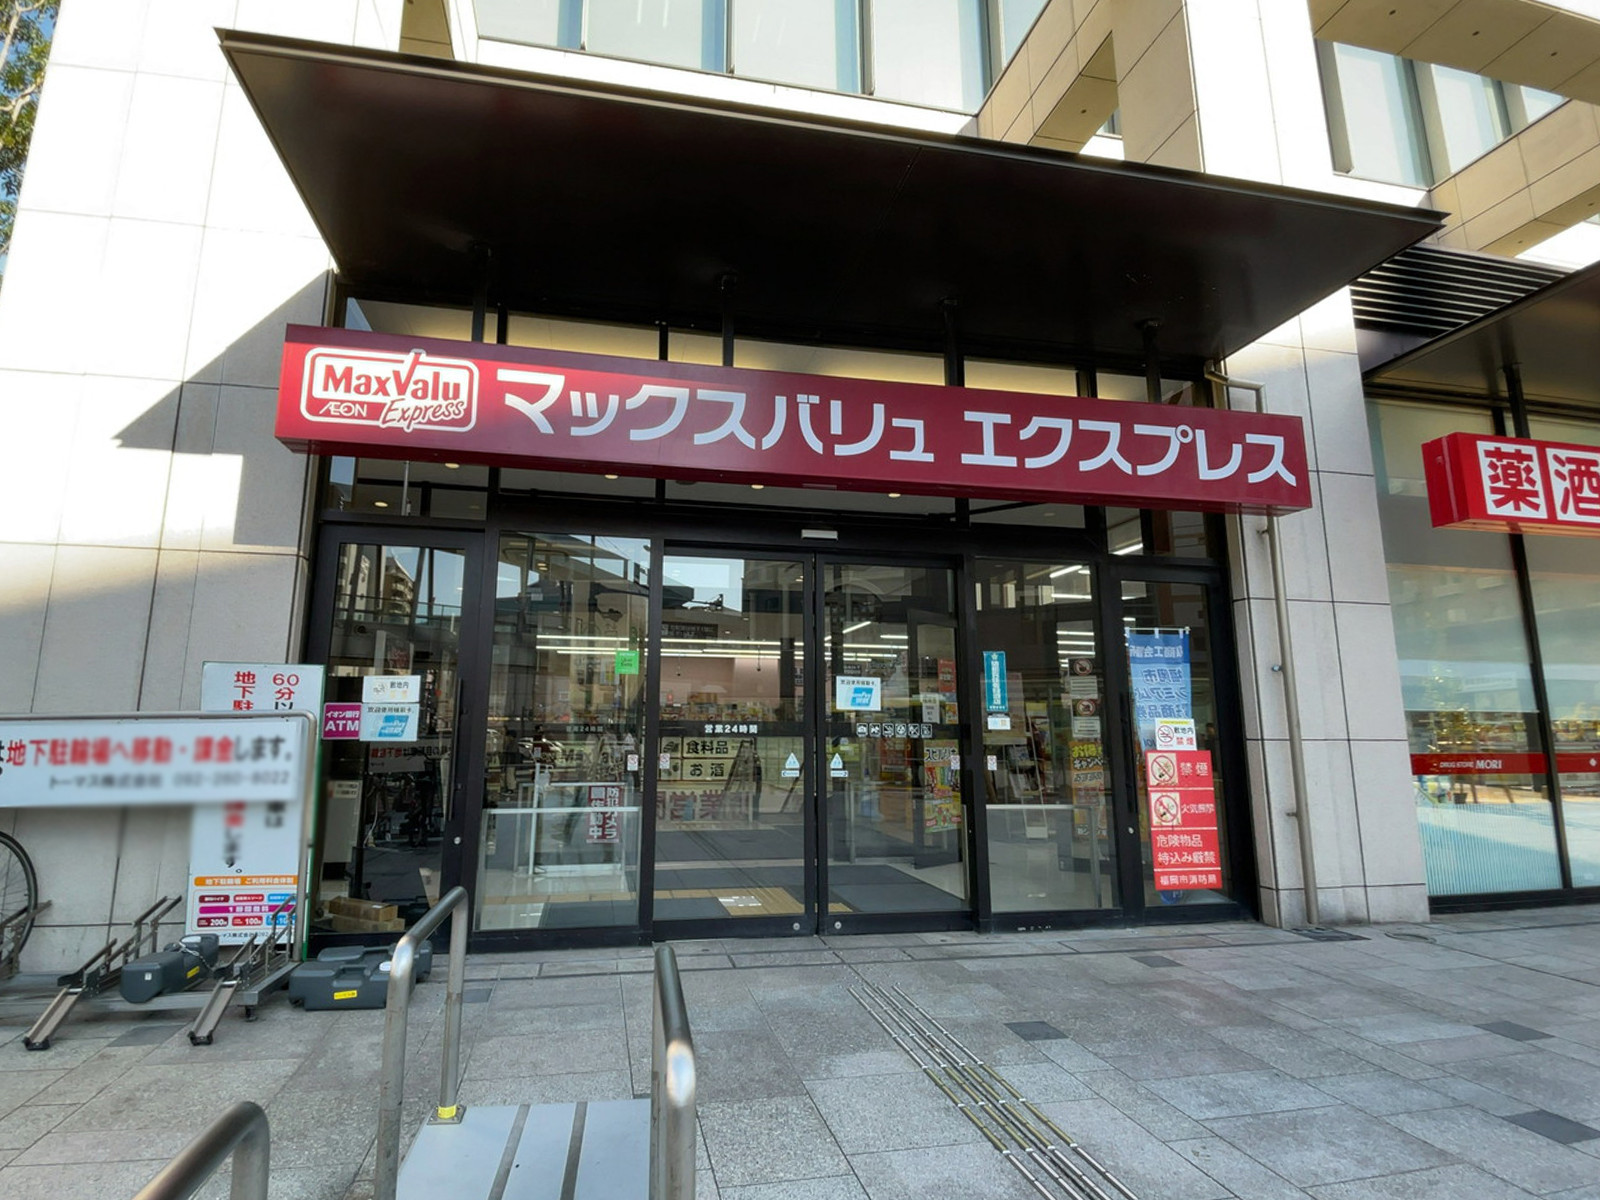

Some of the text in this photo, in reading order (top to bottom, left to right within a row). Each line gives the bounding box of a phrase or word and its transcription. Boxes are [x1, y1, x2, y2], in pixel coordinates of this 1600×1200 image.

[323, 349, 462, 401] MaxValu
[380, 398, 467, 432] Express
[496, 368, 1297, 487] マックスバリュ エクスプレス
[1484, 446, 1600, 517] 薬 酒
[325, 720, 359, 731] ATM
[704, 724, 758, 734] 営業24時間
[686, 740, 728, 754] 食料品
[690, 762, 725, 777] お酒
[1181, 762, 1208, 776] 禁煙
[1475, 760, 1502, 769] MORI
[1157, 834, 1203, 847] 危険物品
[1158, 852, 1216, 865] 持込み厳禁
